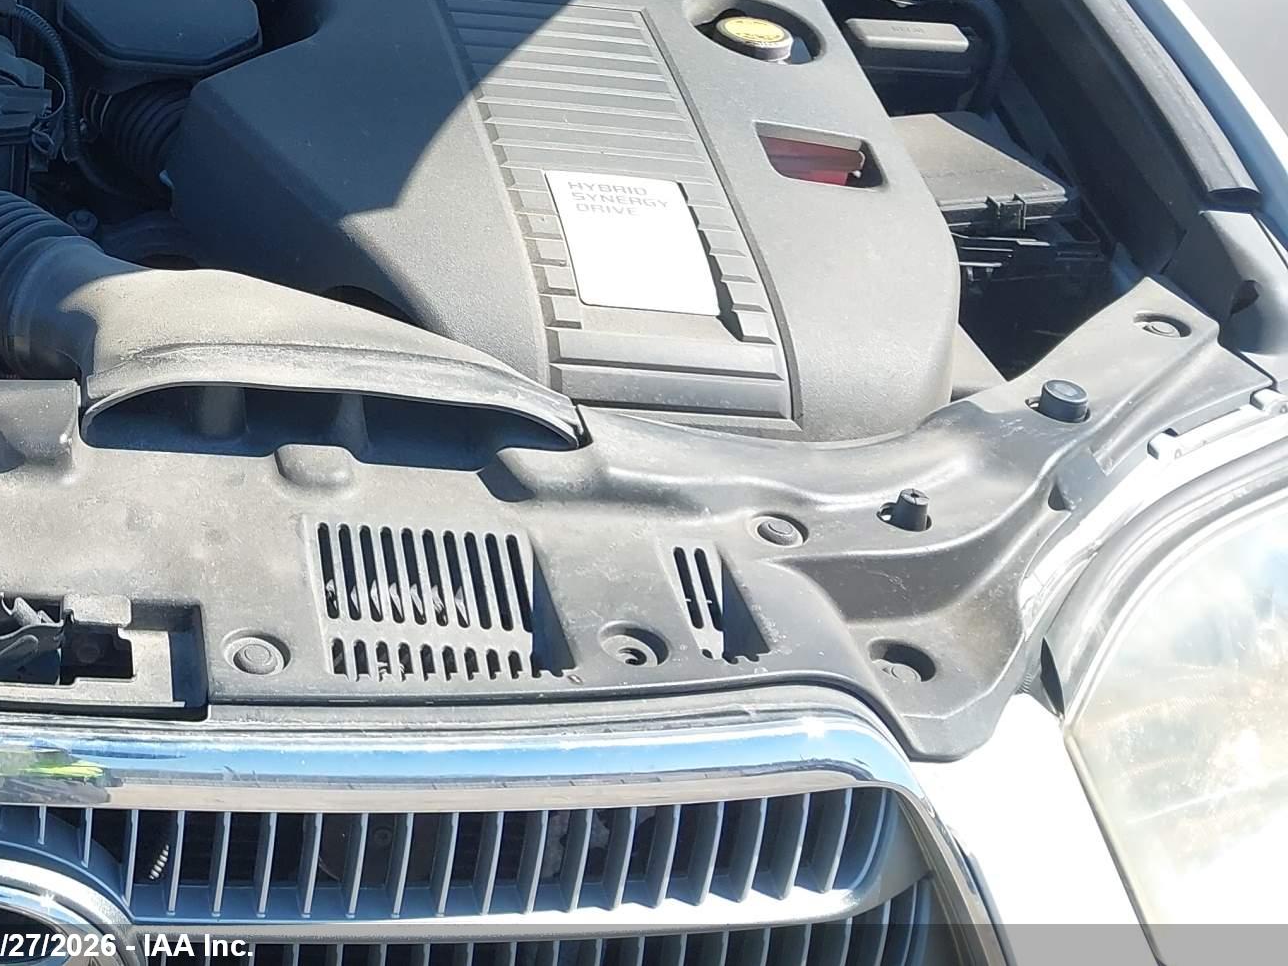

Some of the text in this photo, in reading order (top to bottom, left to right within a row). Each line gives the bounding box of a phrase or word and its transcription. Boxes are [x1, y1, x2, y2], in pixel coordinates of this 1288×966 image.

[568, 182, 648, 196] HYBRID
[571, 192, 668, 208] SYNERGY
[575, 203, 638, 215] DRIVE
